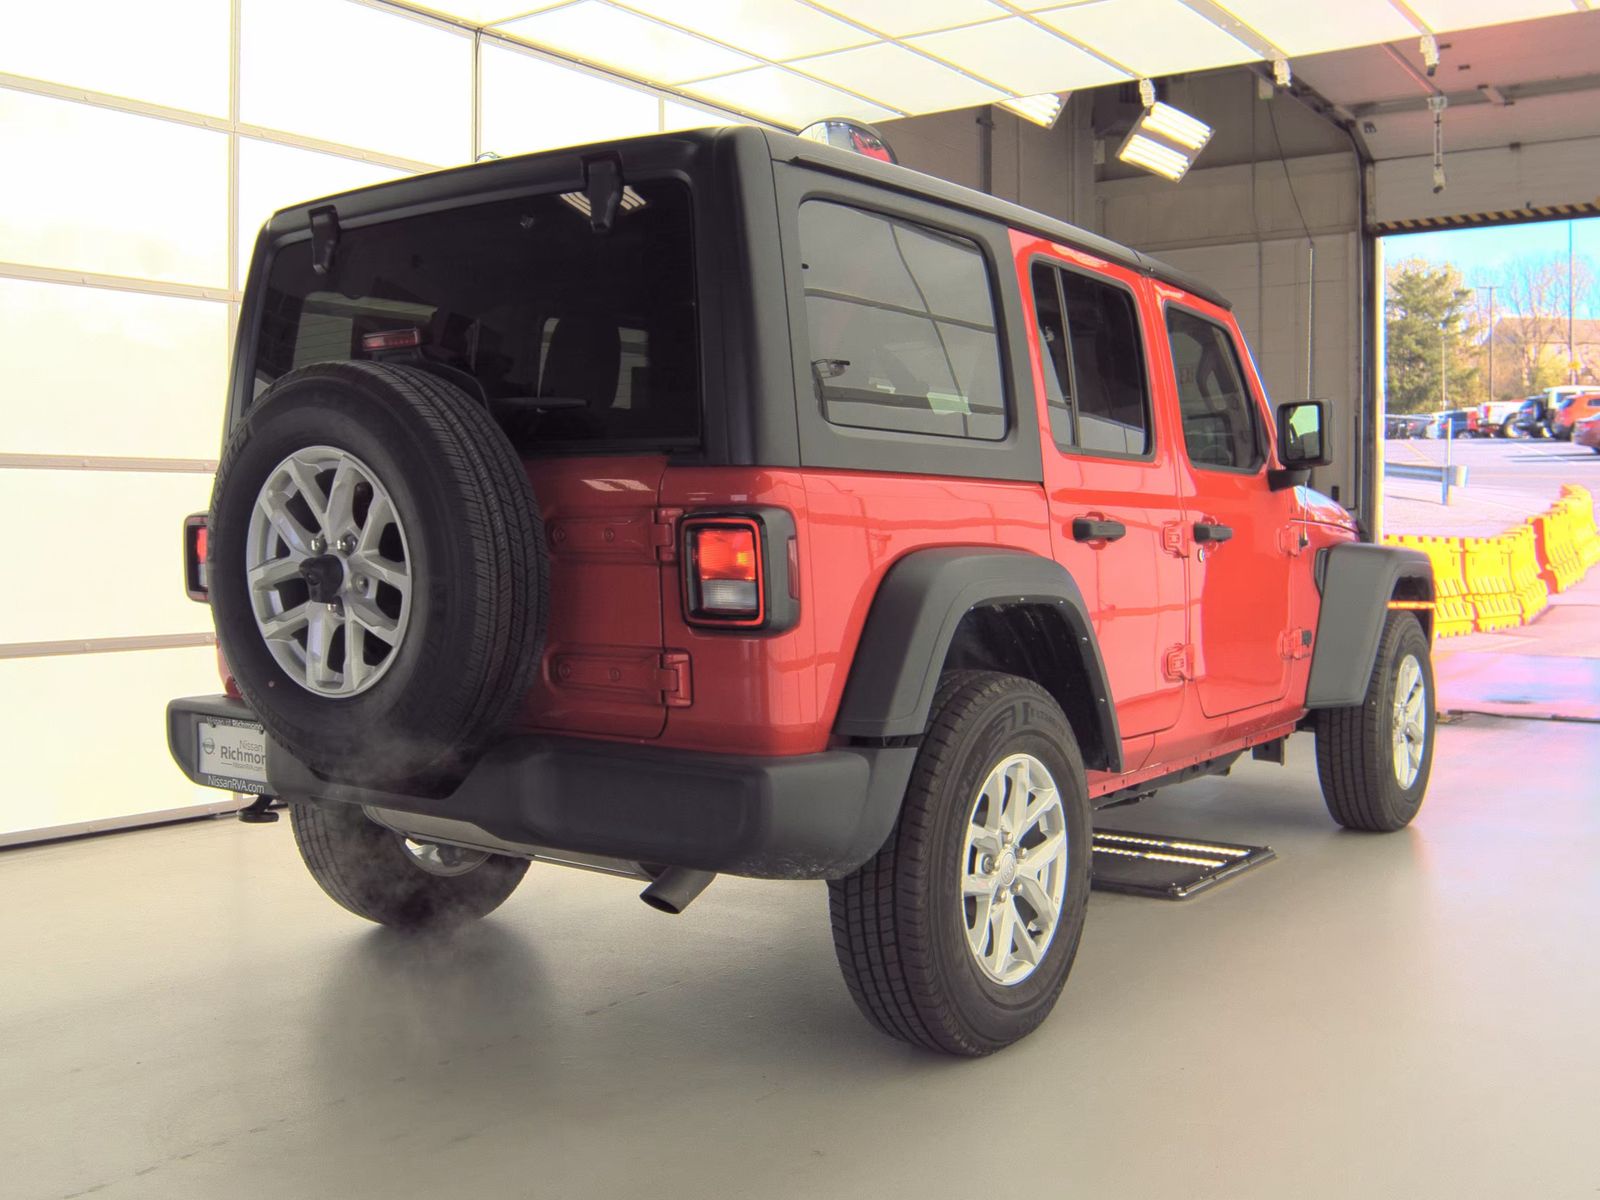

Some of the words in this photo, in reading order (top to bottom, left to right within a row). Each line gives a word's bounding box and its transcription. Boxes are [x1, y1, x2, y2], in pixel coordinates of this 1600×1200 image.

[239, 740, 263, 752] Nissan
[220, 746, 267, 765] Richmon
[208, 776, 265, 793] NissanRVA.com
